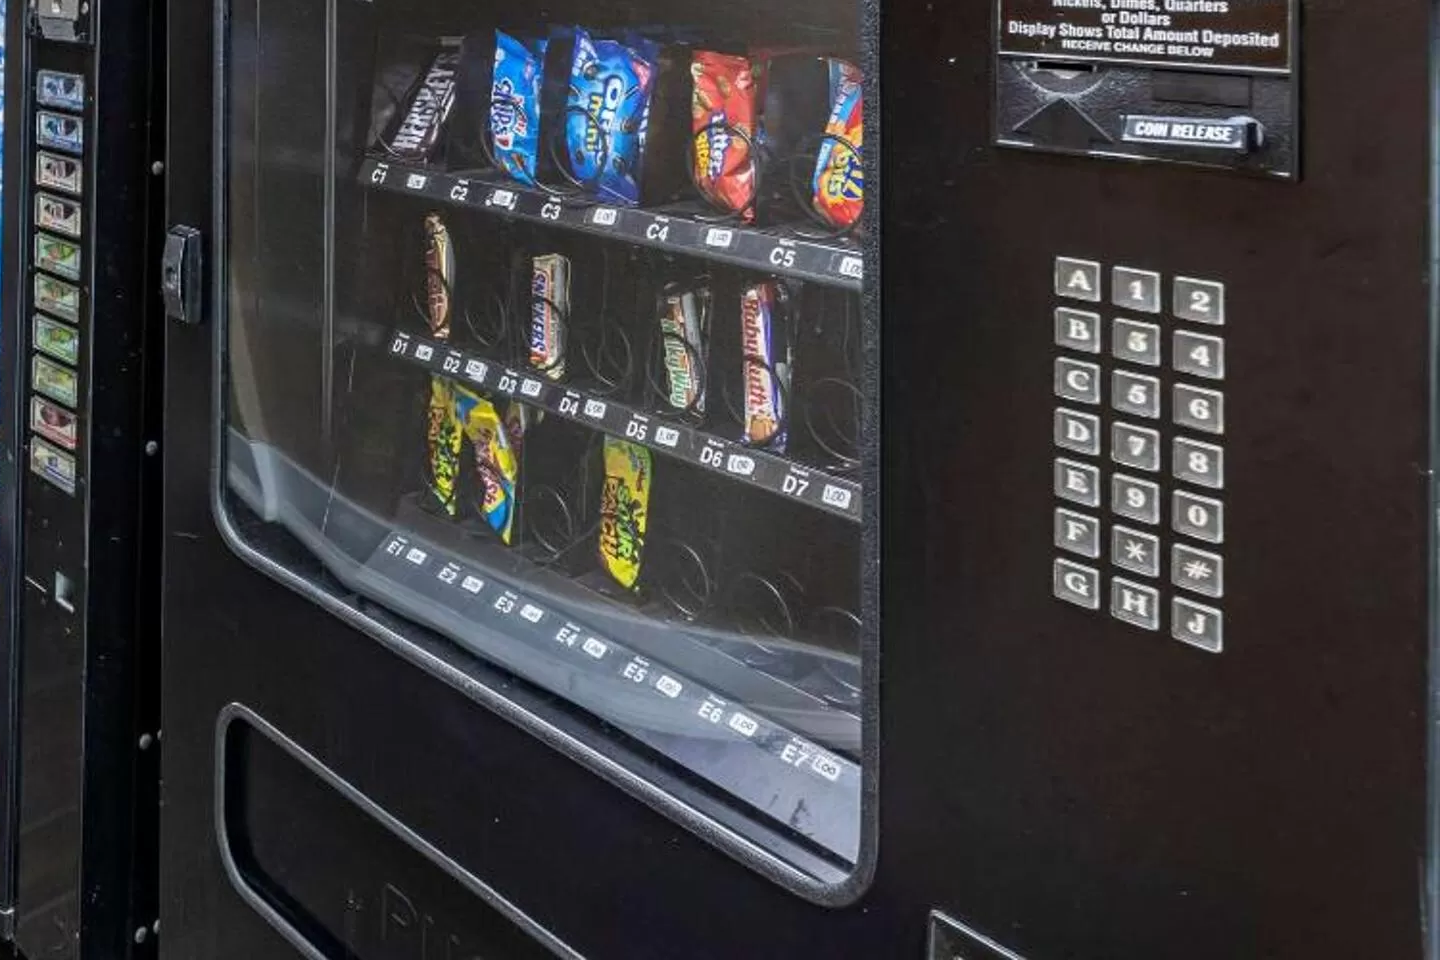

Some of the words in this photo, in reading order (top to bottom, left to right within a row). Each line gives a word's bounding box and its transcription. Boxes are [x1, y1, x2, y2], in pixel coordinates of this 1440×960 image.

[1008, 21, 1056, 39] Display
[1059, 23, 1103, 38] Shows
[1106, 25, 1140, 40] Total
[1143, 28, 1199, 43] Amount
[1203, 30, 1279, 48] Deposited
[1101, 13, 1117, 24] or
[1119, 11, 1171, 26] Dollars
[1062, 39, 1111, 52] RECEIVE
[1114, 41, 1165, 54] CHANGE
[1167, 44, 1214, 58] BELOW
[1135, 122, 1169, 138] COIN
[1172, 124, 1233, 141] RELEASE
[371, 169, 387, 183] C1
[450, 186, 468, 201] C2
[541, 203, 561, 220] C3
[646, 224, 669, 241] C4
[769, 247, 797, 267] C5
[531, 274, 546, 352] SNCKERS
[1067, 269, 1092, 291] A
[1130, 280, 1144, 300] 1
[1190, 291, 1211, 313] 2
[1069, 319, 1090, 340] B
[1128, 331, 1147, 352] 3
[1190, 345, 1210, 367] 4
[392, 340, 408, 355] D1
[443, 356, 461, 373] D2
[498, 375, 517, 393] D3
[560, 397, 579, 416] D4
[625, 420, 648, 440] D5
[700, 446, 723, 468] D6
[782, 474, 809, 497] D7
[1067, 371, 1089, 391] C
[1128, 384, 1146, 404] 5
[1189, 398, 1210, 420] 6
[1067, 421, 1089, 441] D
[1128, 435, 1146, 456] 7
[1189, 452, 1209, 474] 8
[1067, 471, 1089, 493] E
[1127, 487, 1145, 508] 9
[1188, 505, 1208, 527] 0
[1067, 521, 1087, 541] F
[1185, 559, 1212, 580] #
[1065, 572, 1089, 595] G
[1122, 593, 1148, 618] H
[1188, 612, 1205, 635] J
[386, 540, 404, 557] E1
[437, 566, 458, 585] E2
[493, 595, 514, 614] E3
[555, 626, 579, 648] E4
[623, 662, 648, 683] E5
[697, 701, 724, 724] E6
[780, 742, 811, 768] E7
